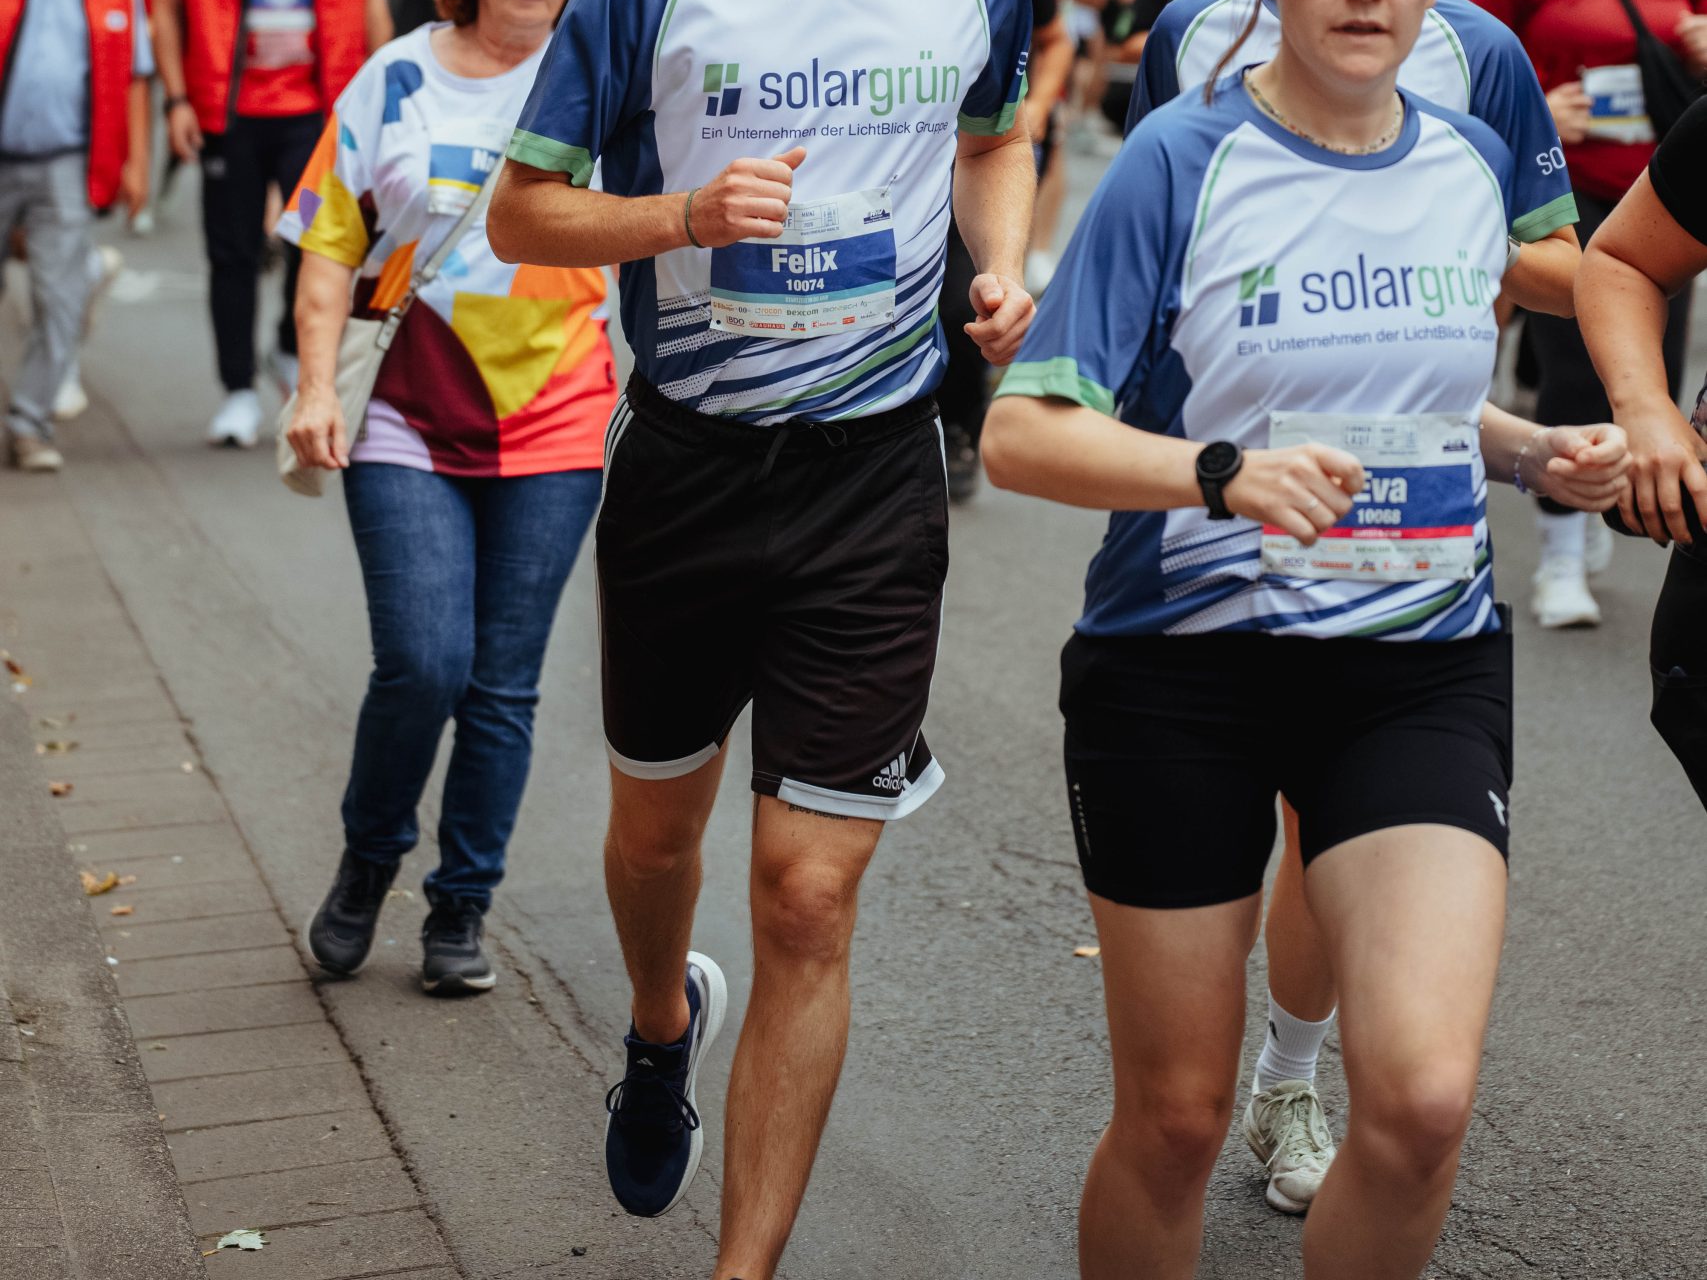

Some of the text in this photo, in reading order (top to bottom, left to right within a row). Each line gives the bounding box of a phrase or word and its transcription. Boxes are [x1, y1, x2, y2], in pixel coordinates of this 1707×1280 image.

[758, 50, 961, 116] solargrün
[701, 120, 949, 140] Ein Unternehmen der LichtBlick Gruppe
[771, 247, 838, 274] Felix
[785, 278, 825, 292] 10074
[1301, 249, 1494, 318] solargrün
[728, 316, 745, 325] BDO
[792, 321, 805, 329] dm
[1237, 340, 1263, 356] Ein
[1267, 332, 1372, 353] Unternehmen
[1375, 329, 1398, 343] der
[1404, 325, 1465, 341] LichtBlick
[1352, 470, 1408, 504] Eva
